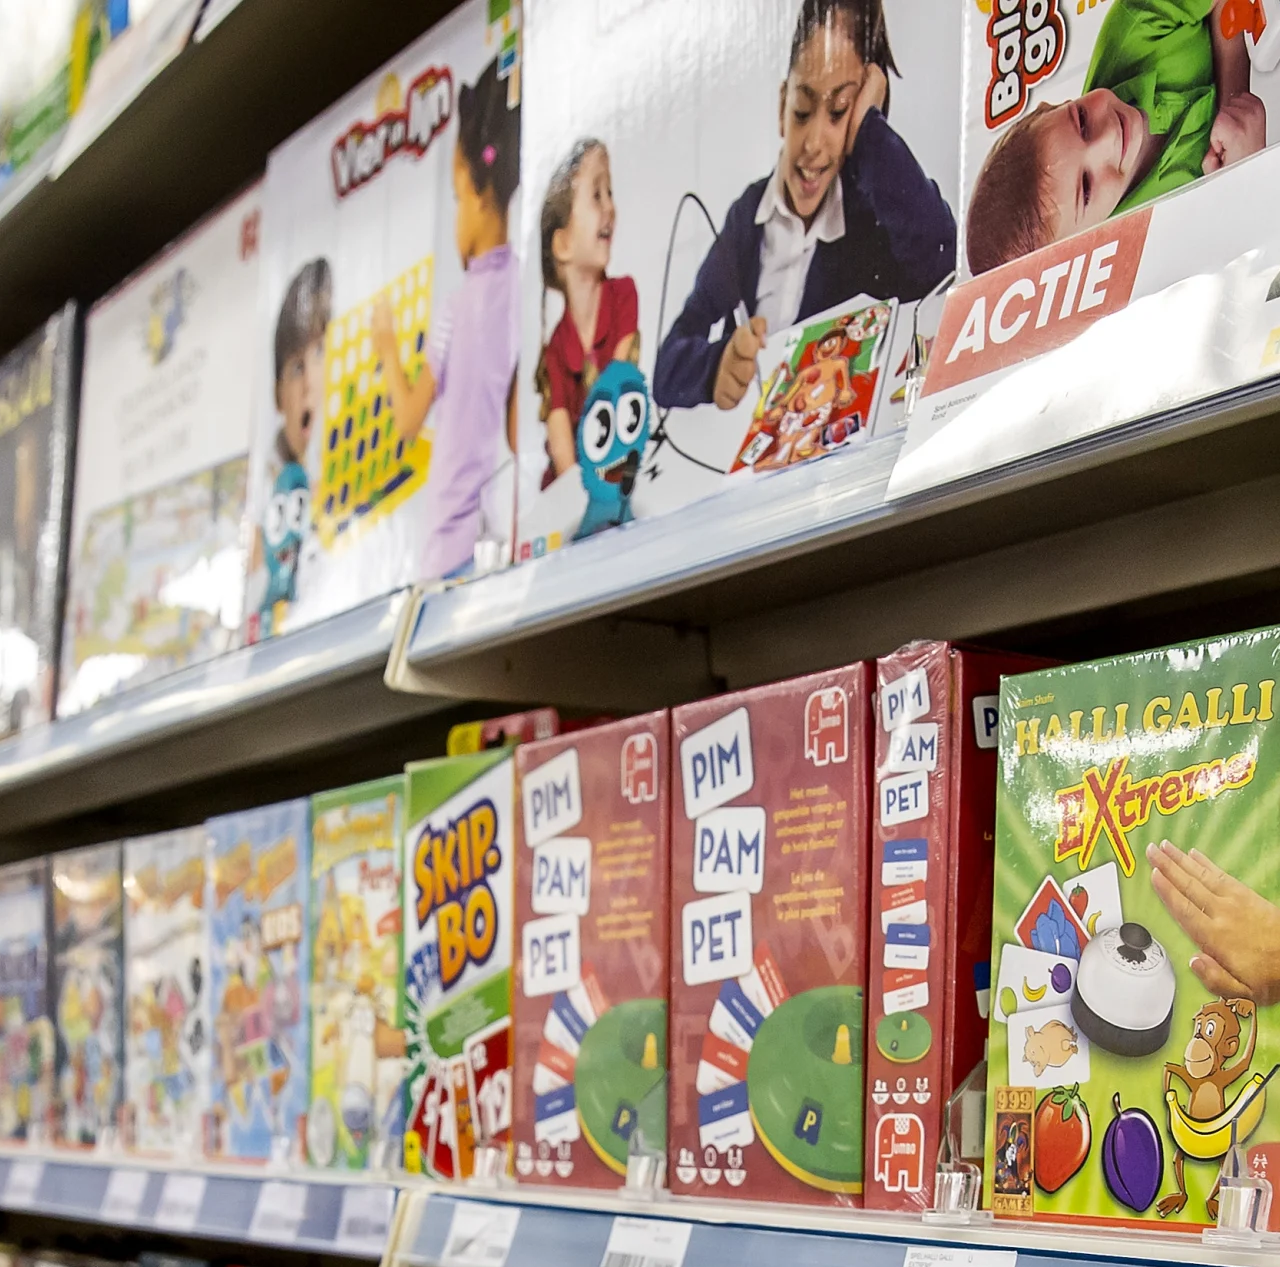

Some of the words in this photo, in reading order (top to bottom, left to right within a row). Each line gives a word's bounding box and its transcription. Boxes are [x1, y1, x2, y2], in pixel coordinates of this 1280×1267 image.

[945, 240, 1120, 364] ACTIE
[888, 681, 923, 721] PIM
[1015, 703, 1129, 758] HALLI
[1142, 679, 1276, 737] GALLI
[691, 733, 742, 799] PIM
[531, 775, 572, 832] PIM
[885, 781, 923, 816] PET
[535, 855, 587, 899] PAM
[699, 828, 761, 876] PAM
[529, 928, 572, 980] PET
[691, 909, 743, 965] PET
[995, 1090, 1033, 1112] 999
[993, 1197, 1031, 1213] GAMES
